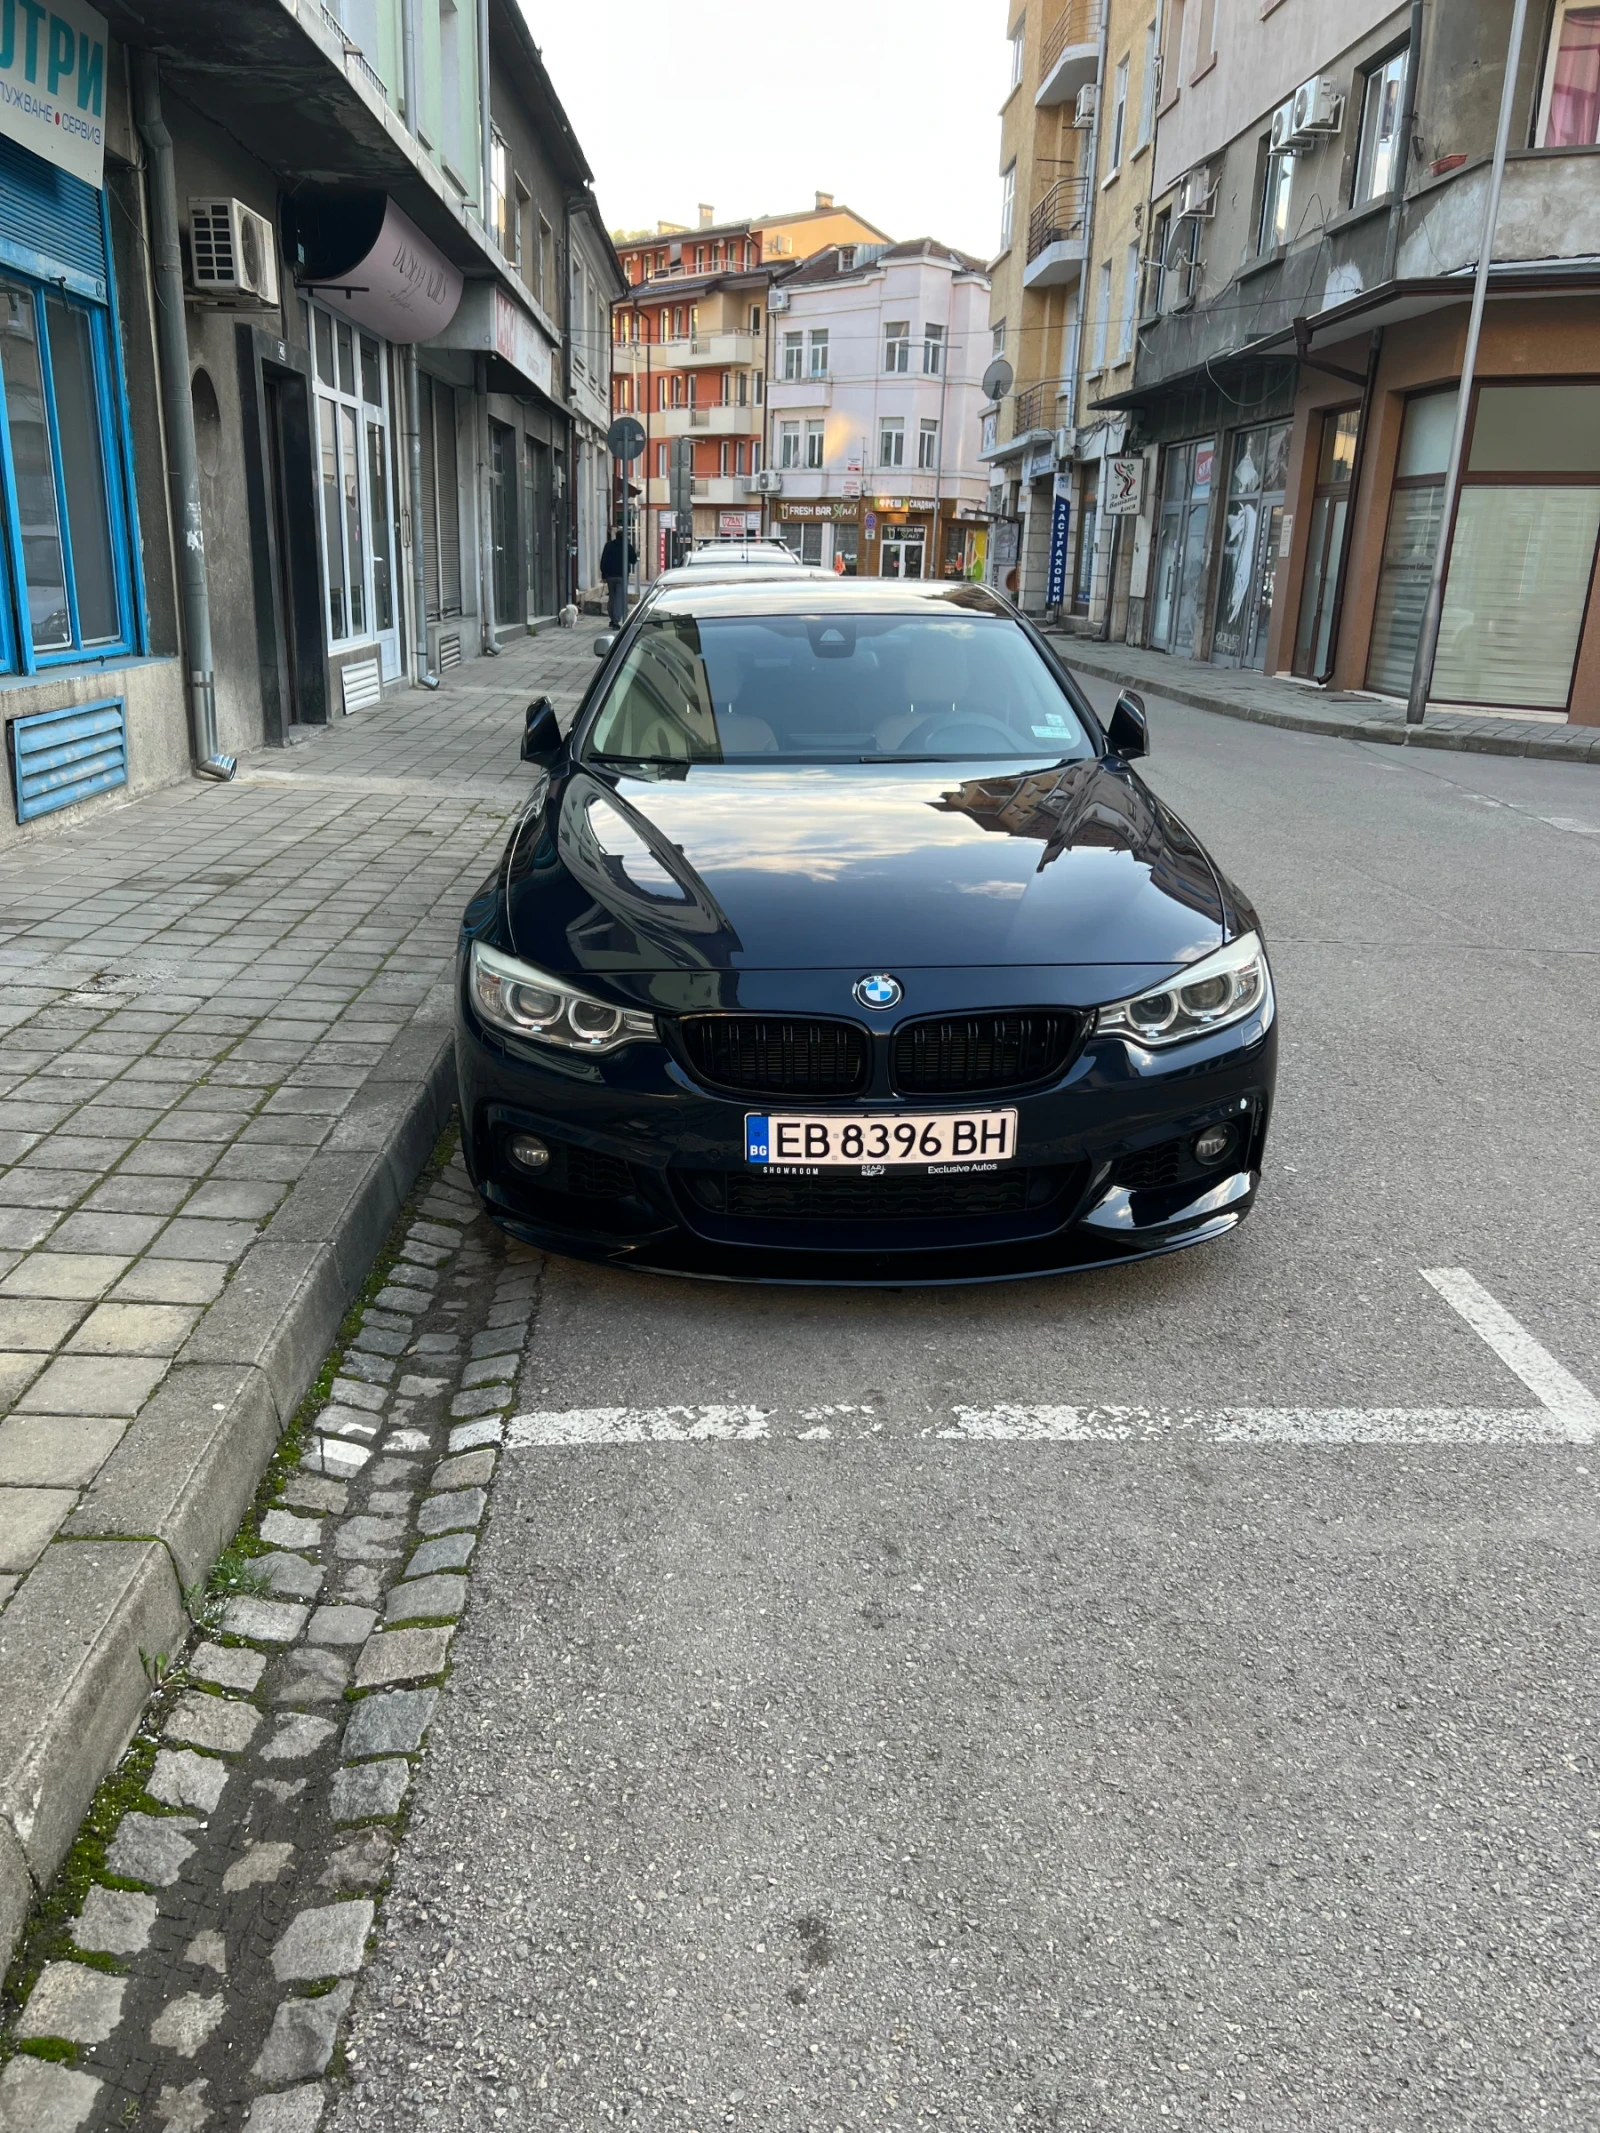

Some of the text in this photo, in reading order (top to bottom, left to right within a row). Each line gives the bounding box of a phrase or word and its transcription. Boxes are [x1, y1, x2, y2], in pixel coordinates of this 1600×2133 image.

[61, 112, 101, 146] СЕРВИЗ
[879, 499, 902, 508] ФРЕШ
[789, 506, 814, 516] FRESH
[815, 506, 831, 516] BAR
[1052, 503, 1067, 603] ЗАСТРАХОВКИ
[776, 1118, 1007, 1159] EB 8396 BH
[750, 1145, 767, 1156] BG
[763, 1166, 819, 1175] SHOWROOM
[927, 1163, 998, 1174] Exclusive Autos
